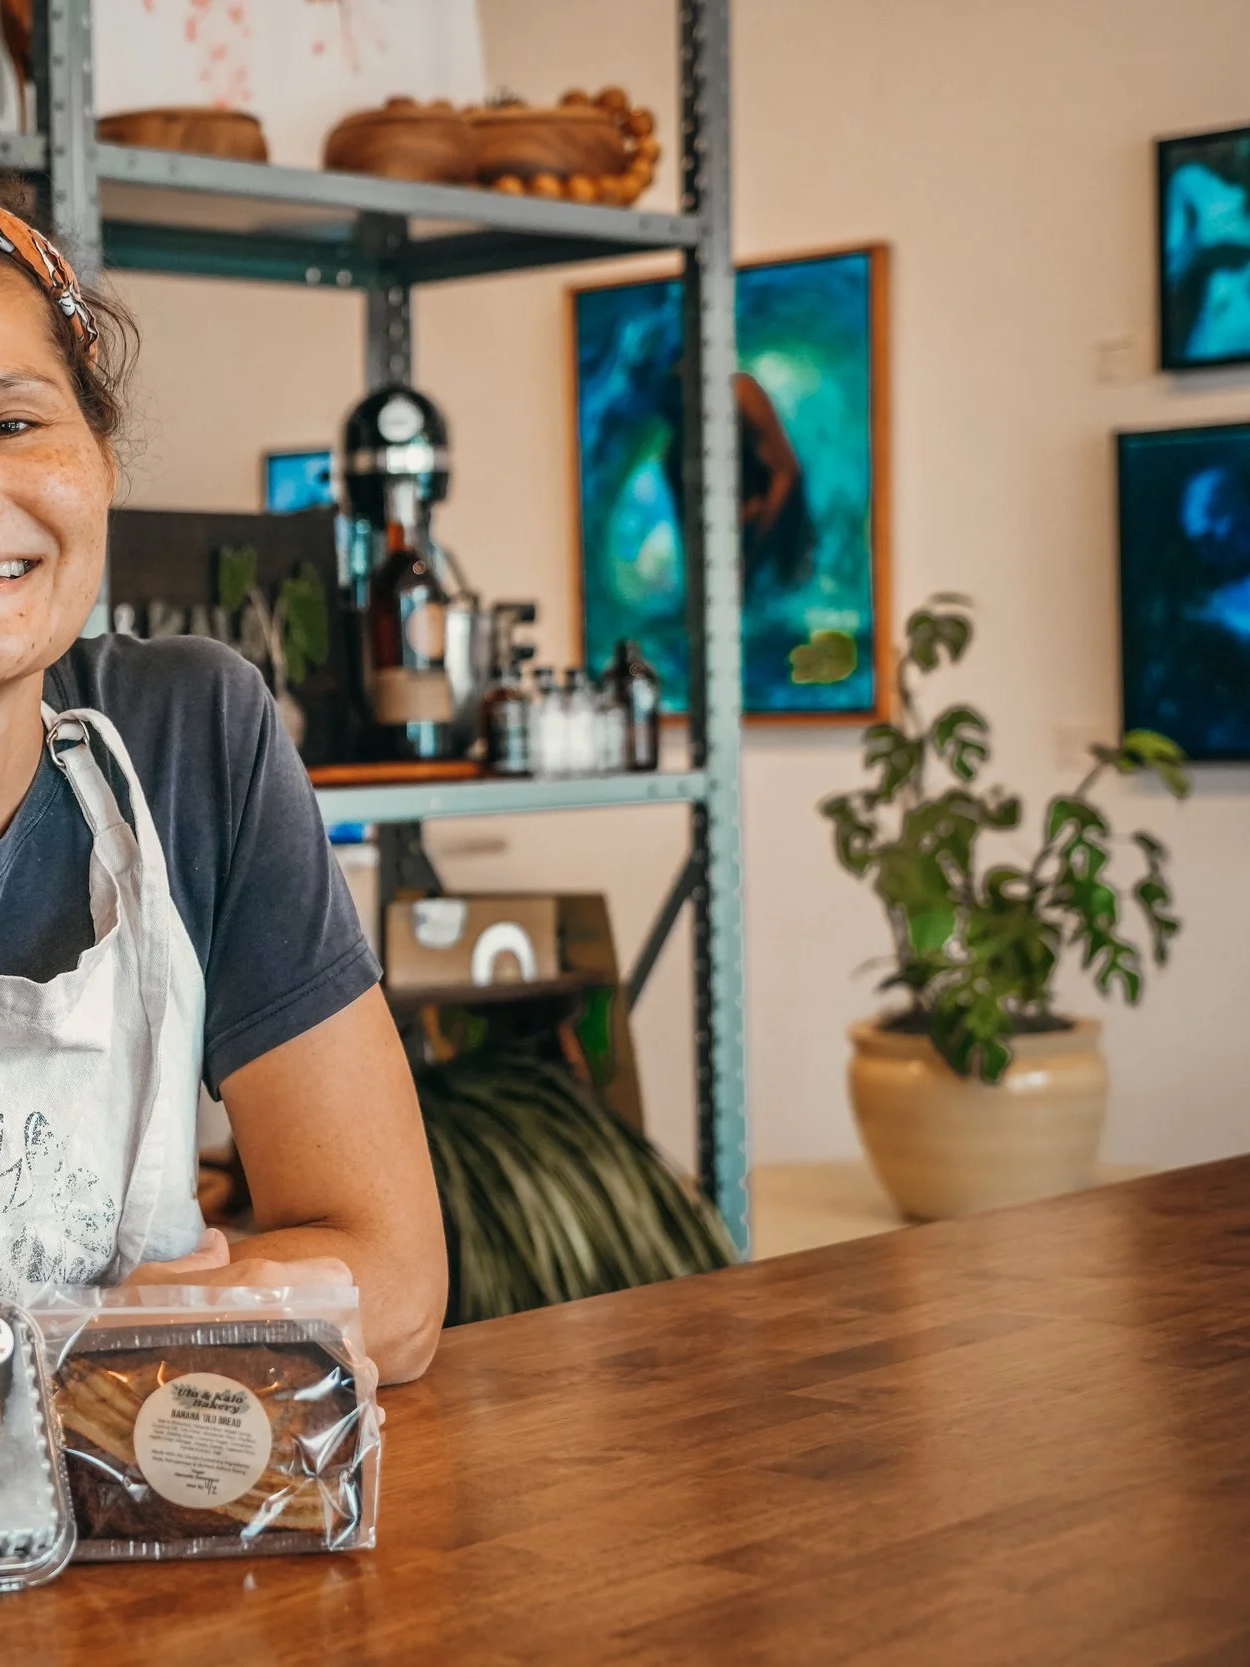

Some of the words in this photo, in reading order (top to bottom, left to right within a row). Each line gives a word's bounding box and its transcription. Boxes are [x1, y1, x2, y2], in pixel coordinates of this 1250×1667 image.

[201, 1392, 211, 1400] &
[215, 1392, 243, 1404] Kalo
[192, 1399, 240, 1414] Bakery
[171, 1409, 200, 1421] BANANA
[218, 1416, 241, 1428] BREAD
